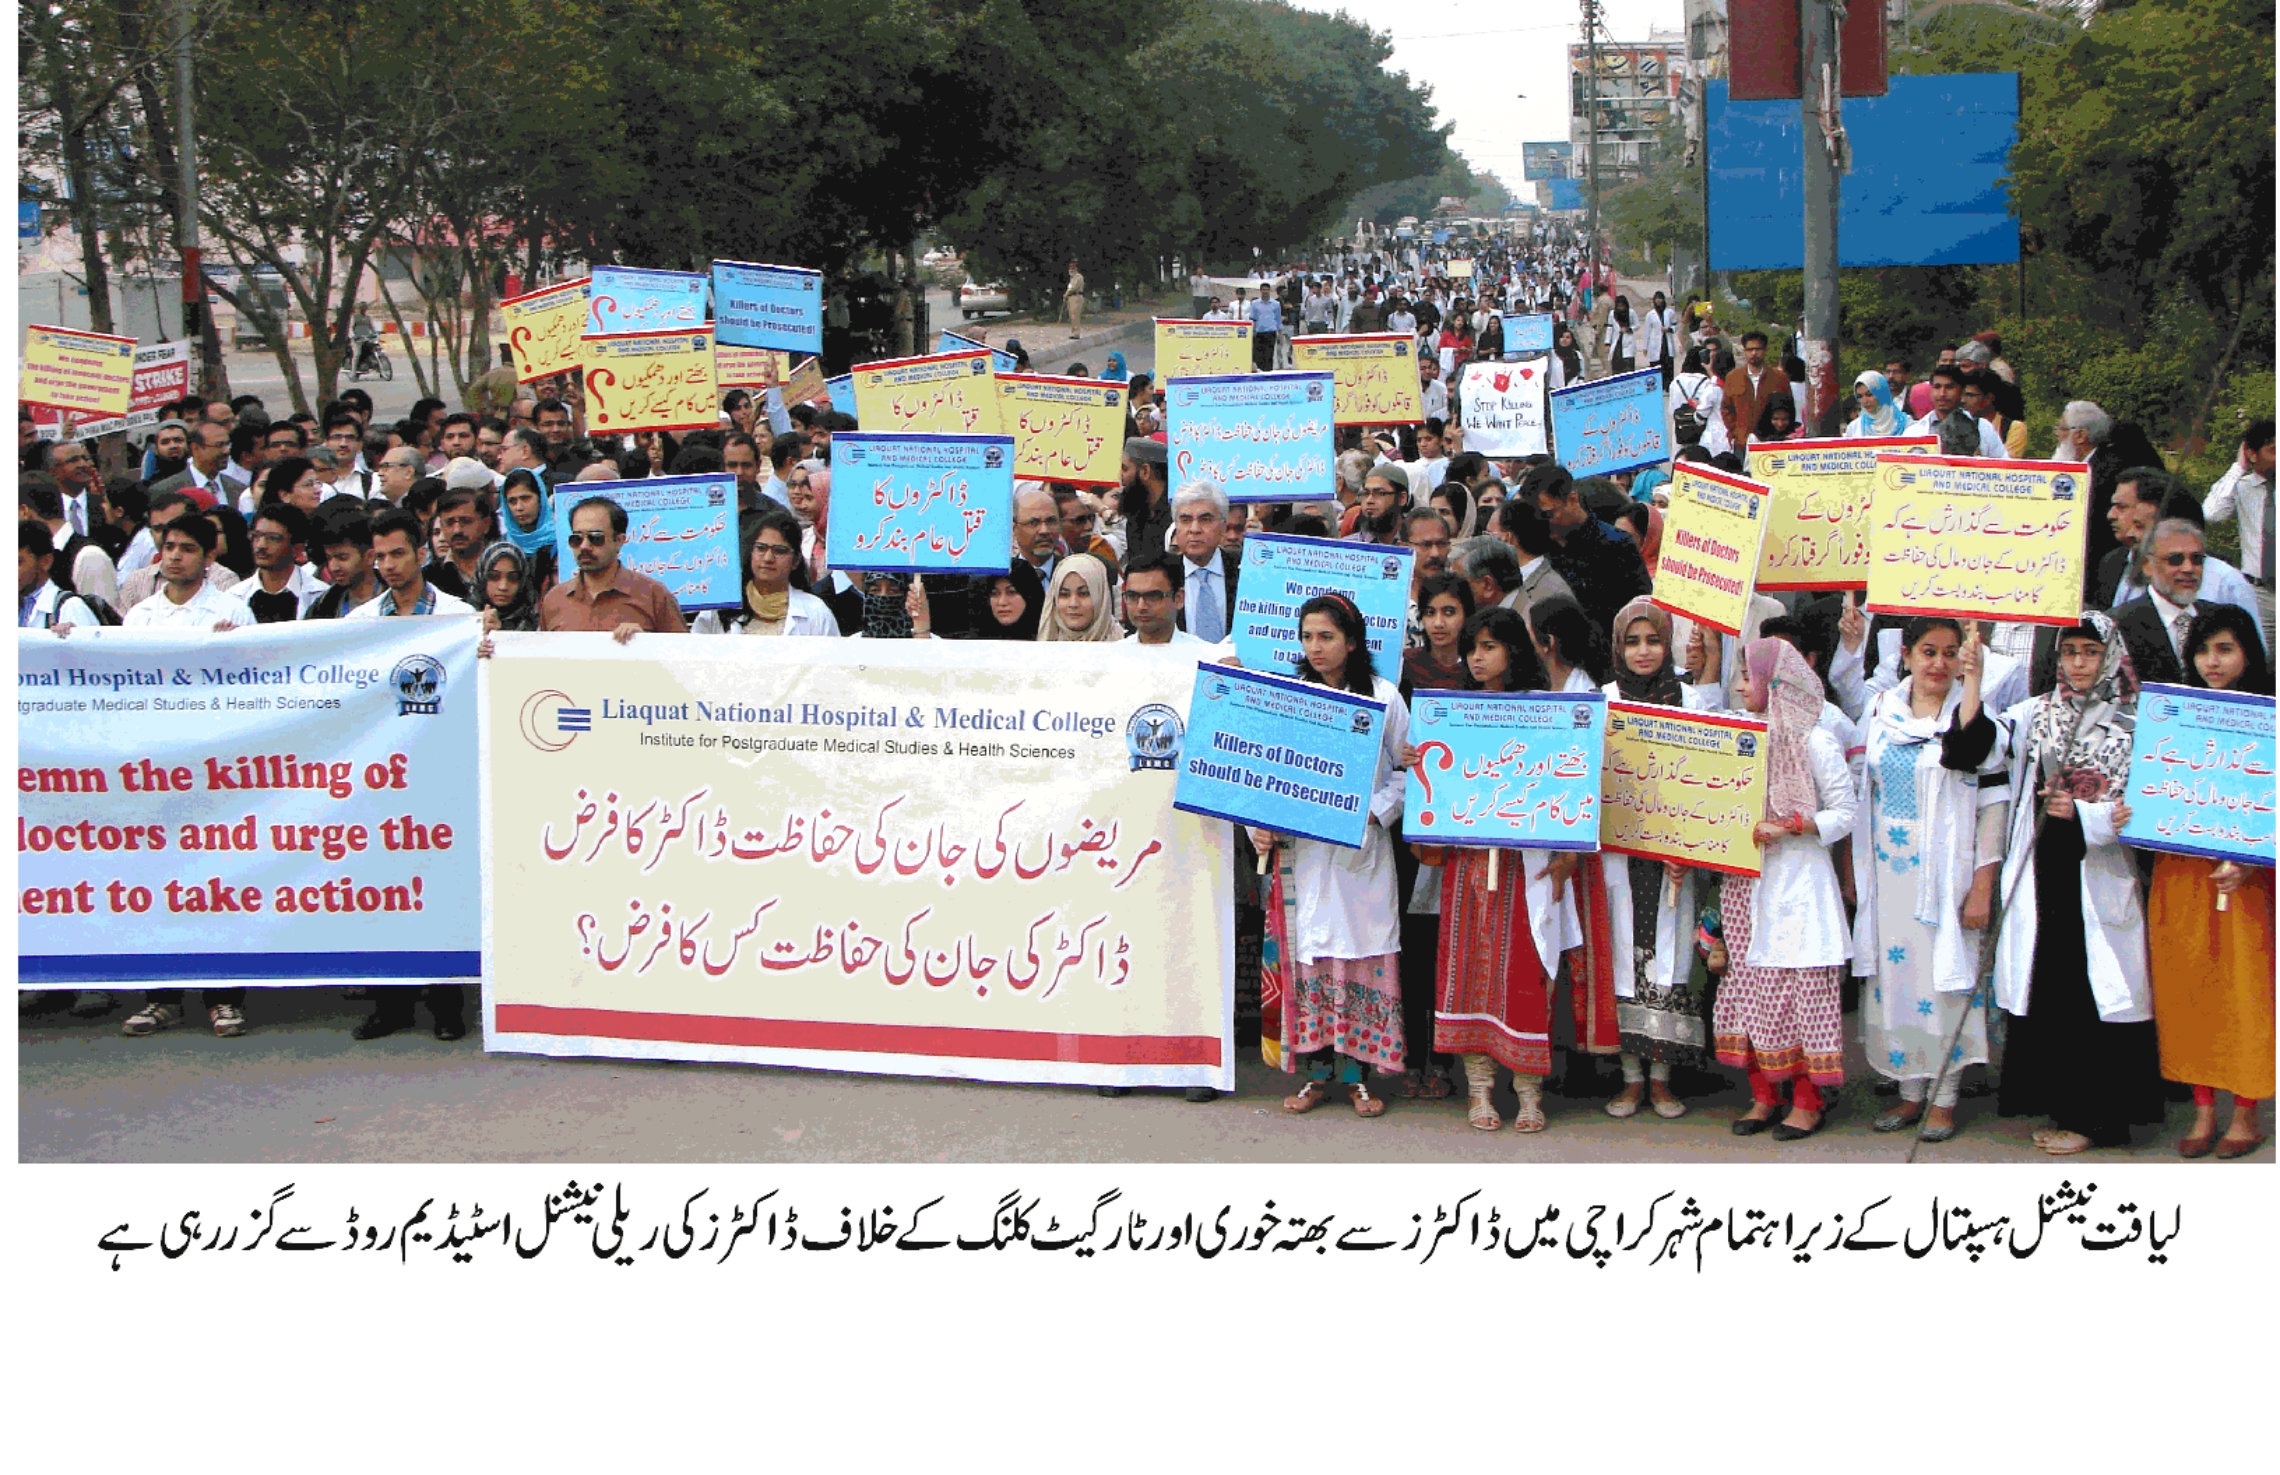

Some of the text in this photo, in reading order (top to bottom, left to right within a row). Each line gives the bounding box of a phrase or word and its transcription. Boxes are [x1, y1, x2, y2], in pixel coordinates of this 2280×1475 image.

[1675, 529, 1740, 564] Killers of Doctors
[1286, 582, 1302, 595] We
[1661, 556, 1744, 597] should be Prosecuted!
[1239, 599, 1291, 618] the killing
[1248, 625, 1295, 641] and urge
[1274, 649, 1285, 661] to
[68, 668, 163, 692] Hospital
[172, 668, 192, 686] &
[201, 665, 291, 686] Medical
[301, 664, 380, 689] College
[92, 698, 148, 711] Medical
[153, 697, 206, 711] Studies
[211, 697, 221, 710] &
[227, 697, 271, 711] Health
[277, 696, 342, 710] Sciences
[602, 698, 1117, 739] Liaquat National Hospital & Medical College
[1234, 682, 1348, 716] LIAQUAT NATIONAL HOSPITAL
[1245, 695, 1334, 723] AND MEDICAL COLLEGE
[640, 732, 1076, 759] Institute for Postgraduate Medical Studies & Health Sciences
[1213, 731, 1344, 778] Killers of Doctors
[119, 758, 194, 792] the
[206, 754, 353, 799] killing
[365, 754, 408, 790] of
[1189, 758, 1360, 812] should be Prosecuted!
[180, 815, 257, 851] and
[271, 823, 368, 860] urge
[380, 816, 453, 850] the
[545, 788, 1162, 888] مریضوں کی جان کی حفاظت ڈاکٹر کا فرض
[18, 876, 424, 914] ent to take action!
[680, 912, 711, 966] کا
[703, 898, 779, 976] کس
[760, 920, 883, 975] حفاظت
[884, 906, 931, 986] کی
[1006, 911, 1056, 991] کی
[1042, 914, 1130, 999] ڈاکٹر
[924, 934, 998, 997] جان
